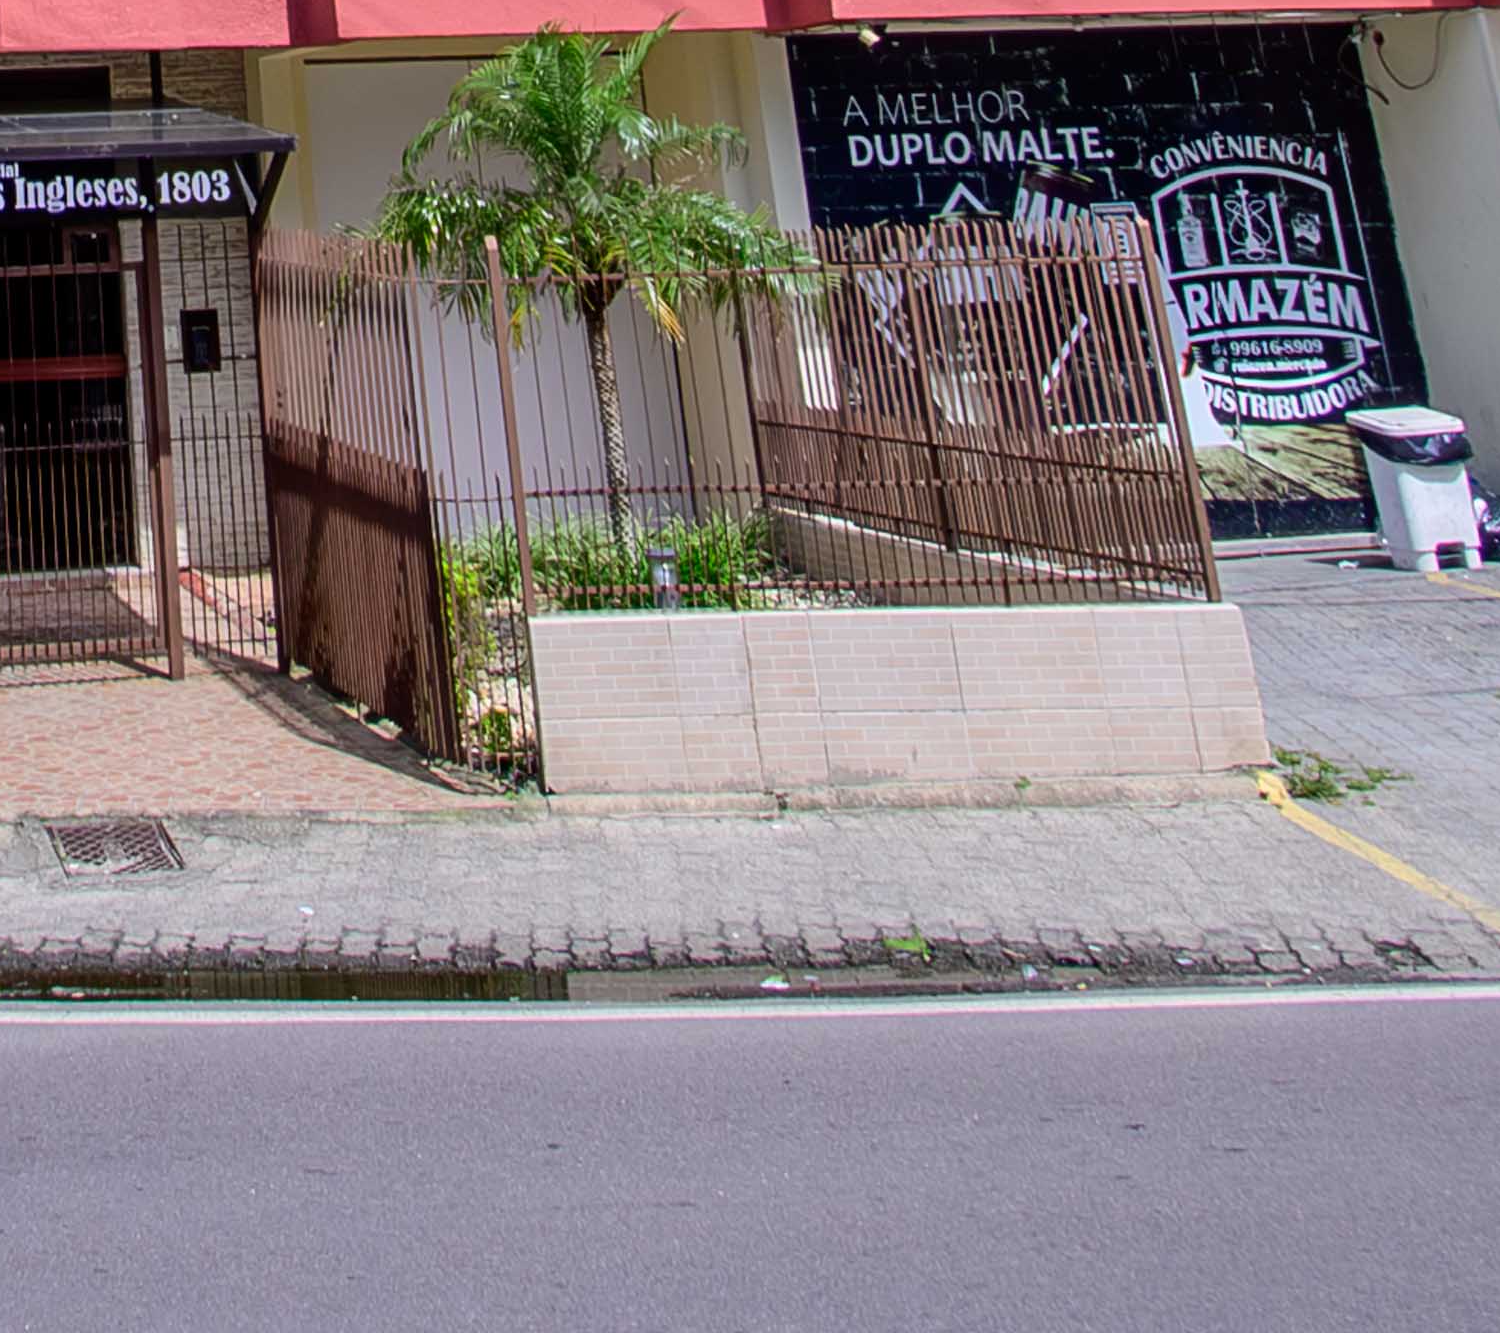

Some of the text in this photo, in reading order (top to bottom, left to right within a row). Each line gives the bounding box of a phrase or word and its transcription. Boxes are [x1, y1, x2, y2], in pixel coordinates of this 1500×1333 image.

[842, 90, 1030, 127] A MELHOR
[847, 126, 1115, 167] DUPLO MALTE.
[14, 175, 148, 214] Ingleses,
[156, 170, 231, 205] 1803
[1182, 274, 1369, 332] RMAZÉM
[1202, 369, 1378, 421] DISTRIBUIDORA
